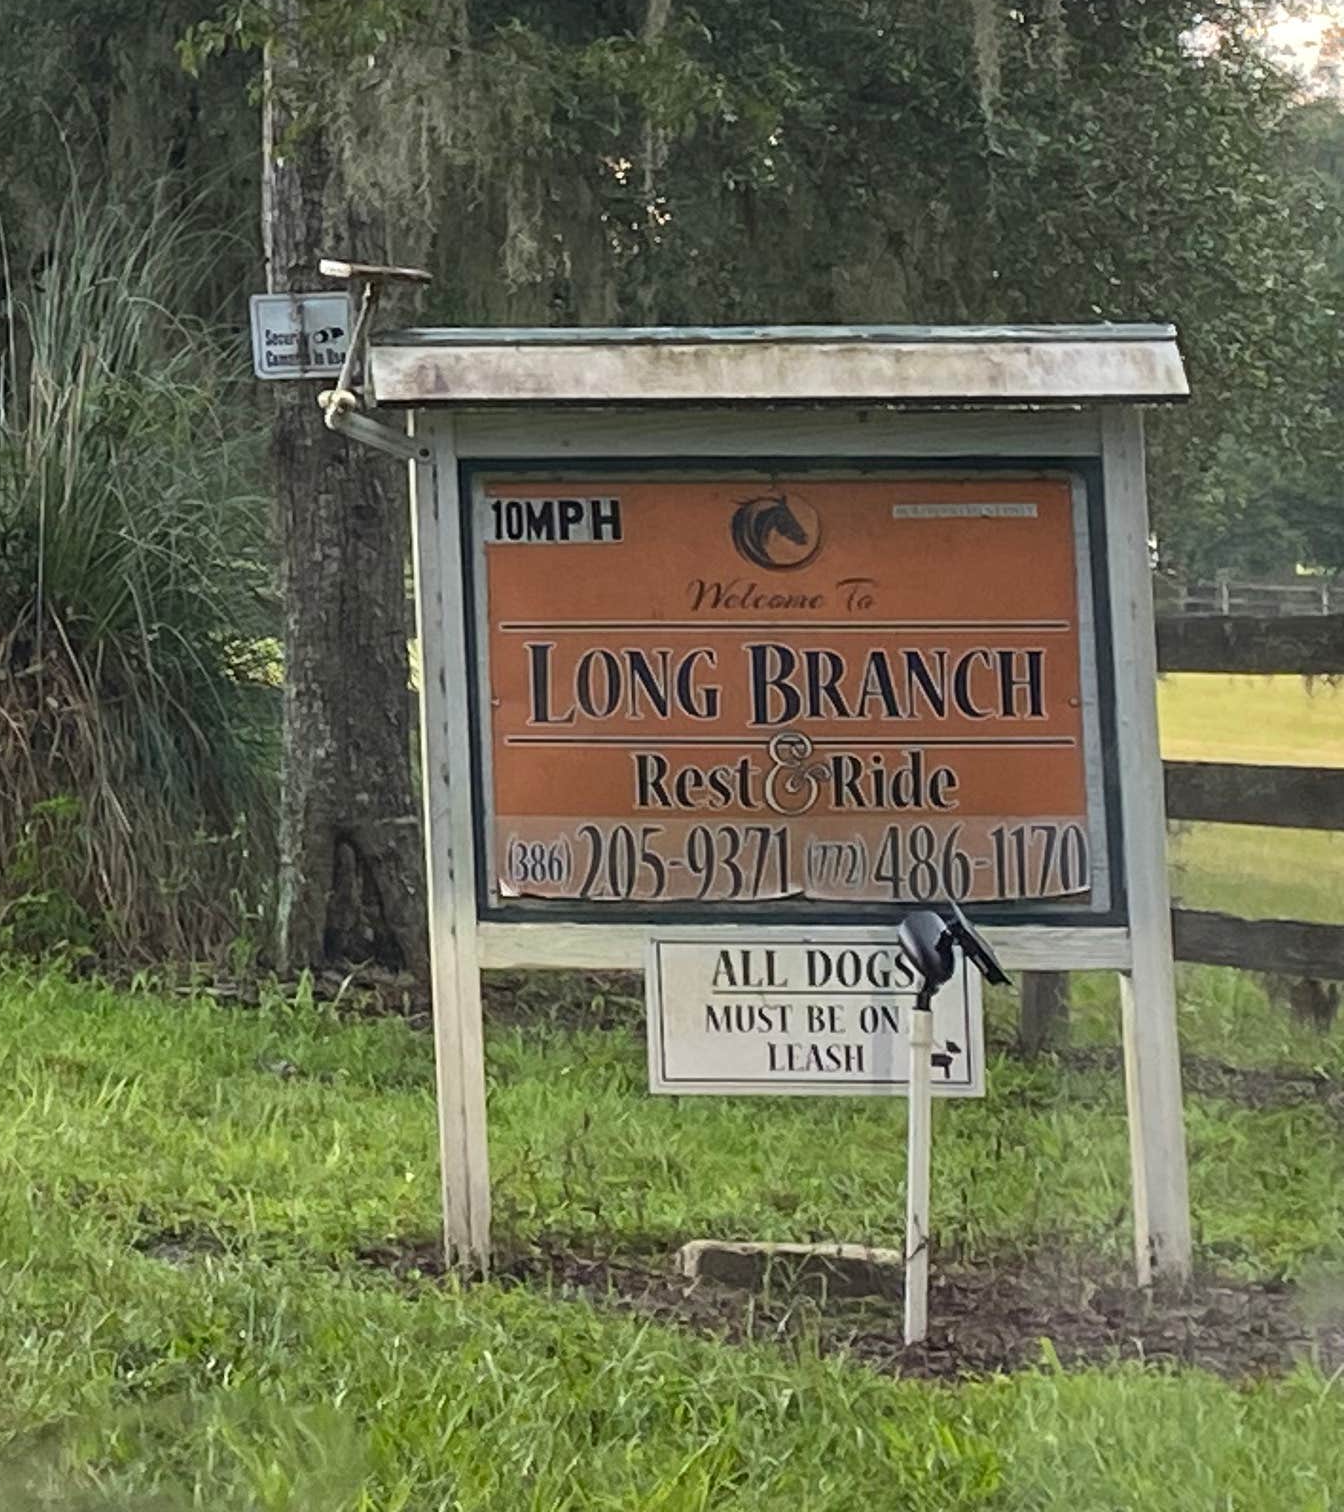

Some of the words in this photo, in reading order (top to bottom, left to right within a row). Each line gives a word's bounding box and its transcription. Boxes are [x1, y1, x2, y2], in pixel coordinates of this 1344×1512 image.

[491, 499, 623, 542] 10MPH
[687, 577, 824, 613] Welcome
[836, 577, 878, 612] To
[524, 643, 720, 726] LONG
[745, 642, 1048, 728] BRANCH
[631, 751, 762, 811] Rest
[765, 732, 830, 816] &
[829, 750, 960, 811] Ride
[507, 834, 574, 888] (386)
[576, 824, 792, 900] 205-9371
[873, 822, 1090, 900] 486-1170
[713, 949, 788, 987] ALL
[806, 948, 916, 988] DOGS
[705, 1004, 794, 1034] MUST
[807, 1004, 846, 1034] BE
[860, 1004, 900, 1035] ON
[768, 1041, 865, 1073] LEASH
